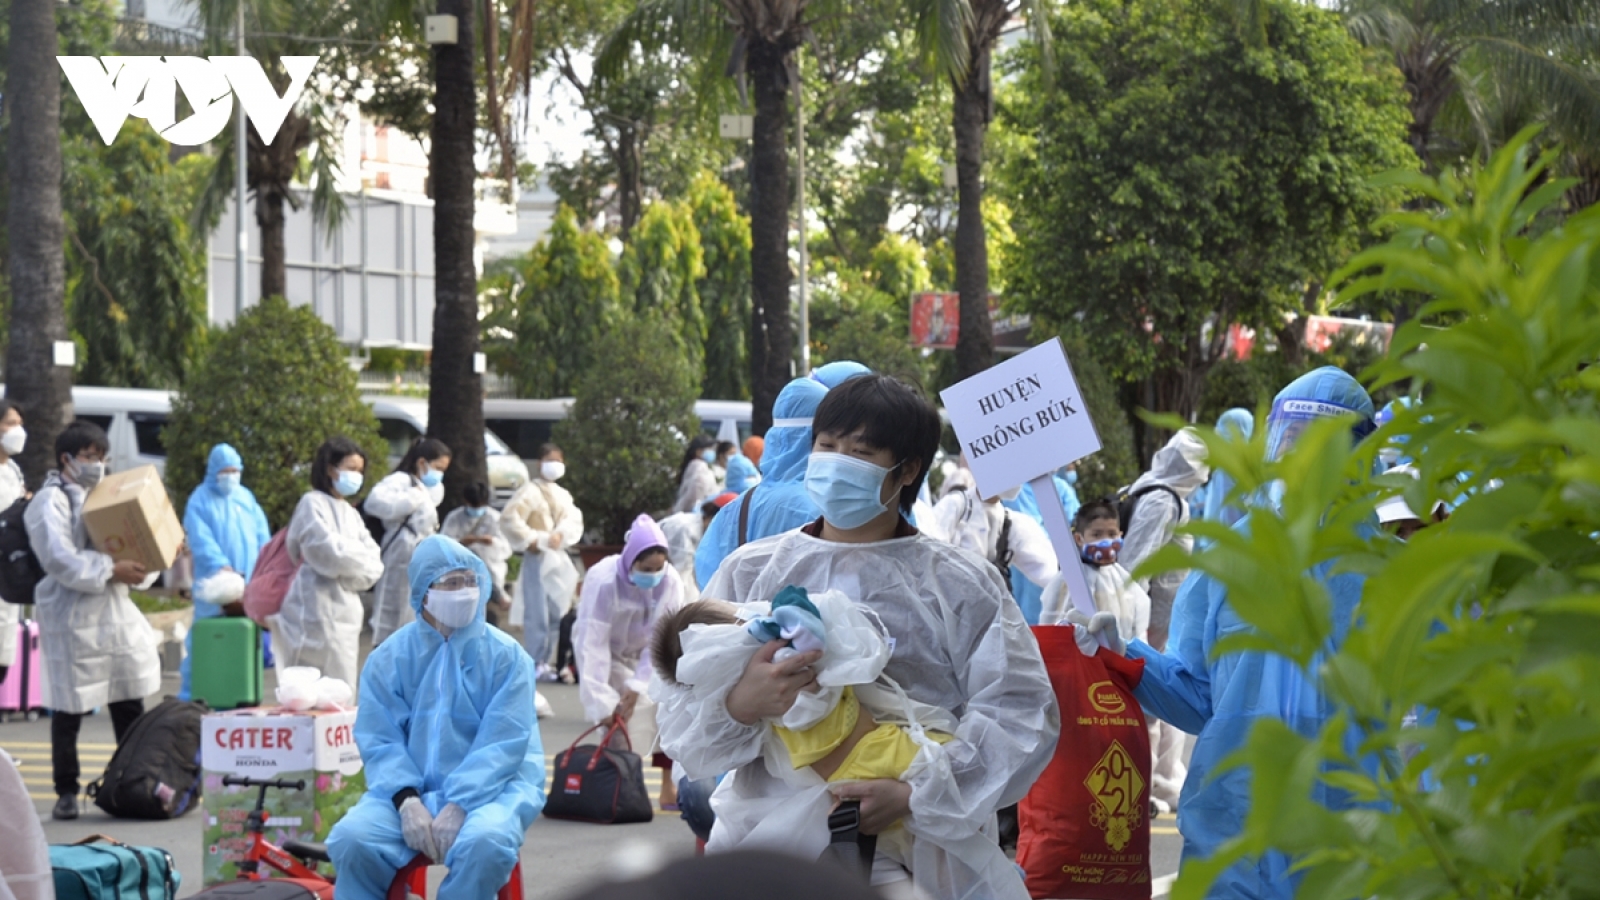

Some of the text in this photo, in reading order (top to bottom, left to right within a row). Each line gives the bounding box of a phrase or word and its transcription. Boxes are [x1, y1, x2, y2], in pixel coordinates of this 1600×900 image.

[978, 373, 1042, 416] HUYỆN
[1289, 402, 1312, 411] Face
[968, 397, 1077, 459] KRÔNG BÚK
[215, 727, 293, 751] CATER
[235, 759, 278, 767] HONDA
[1080, 853, 1108, 862] HAPPY
[1110, 854, 1126, 862] NEW
